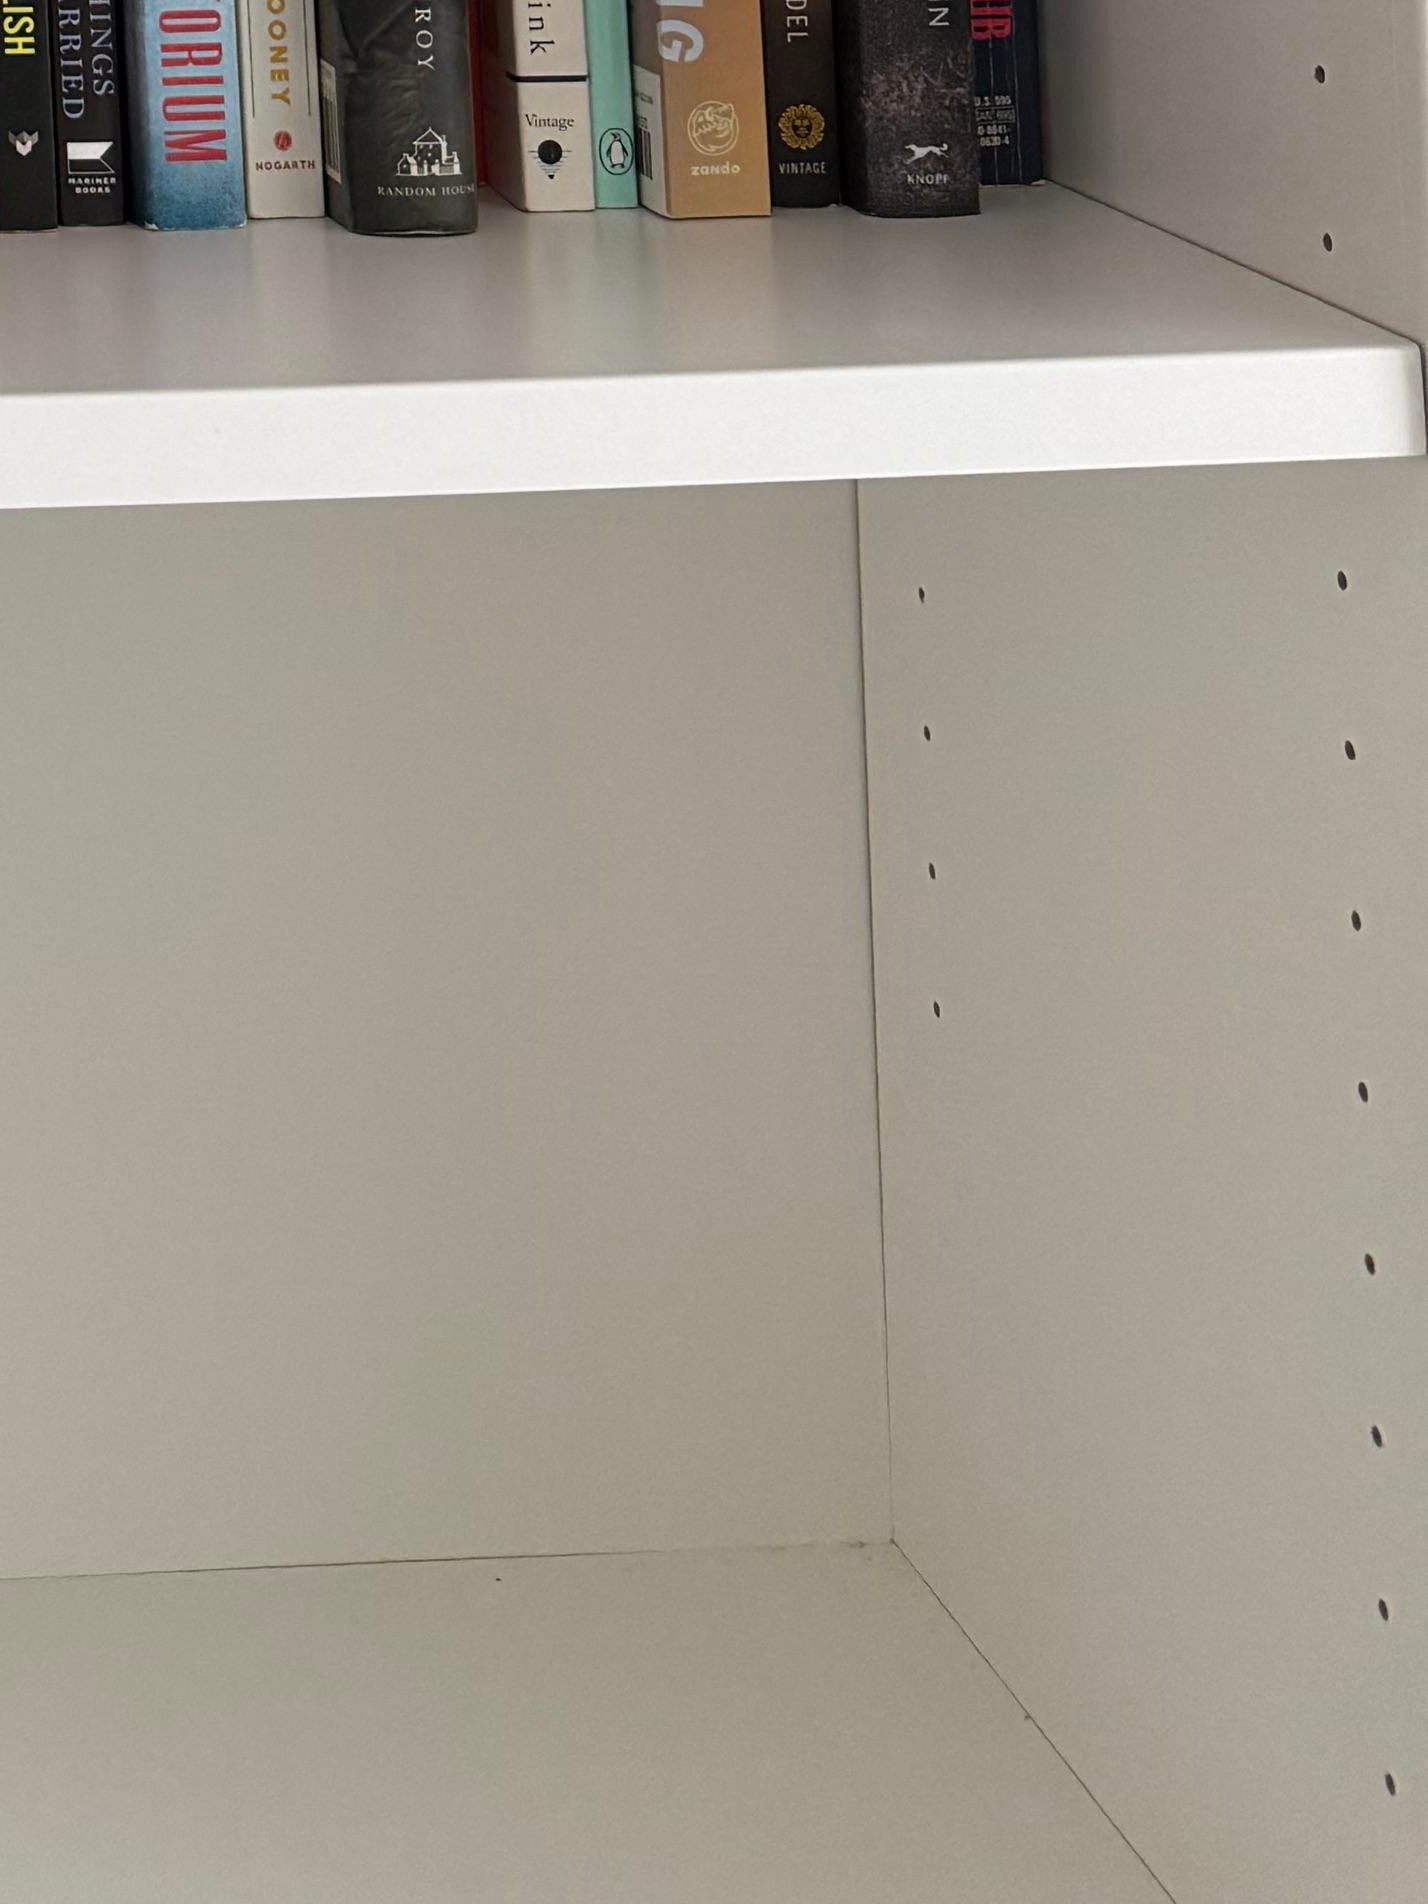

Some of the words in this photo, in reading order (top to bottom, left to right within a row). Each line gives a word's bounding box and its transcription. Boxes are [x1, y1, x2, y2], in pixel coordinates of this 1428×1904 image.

[524, 114, 574, 131] Vintage
[256, 160, 315, 170] HOGARTH
[691, 162, 740, 175] zando
[779, 162, 825, 174] VINTAGE
